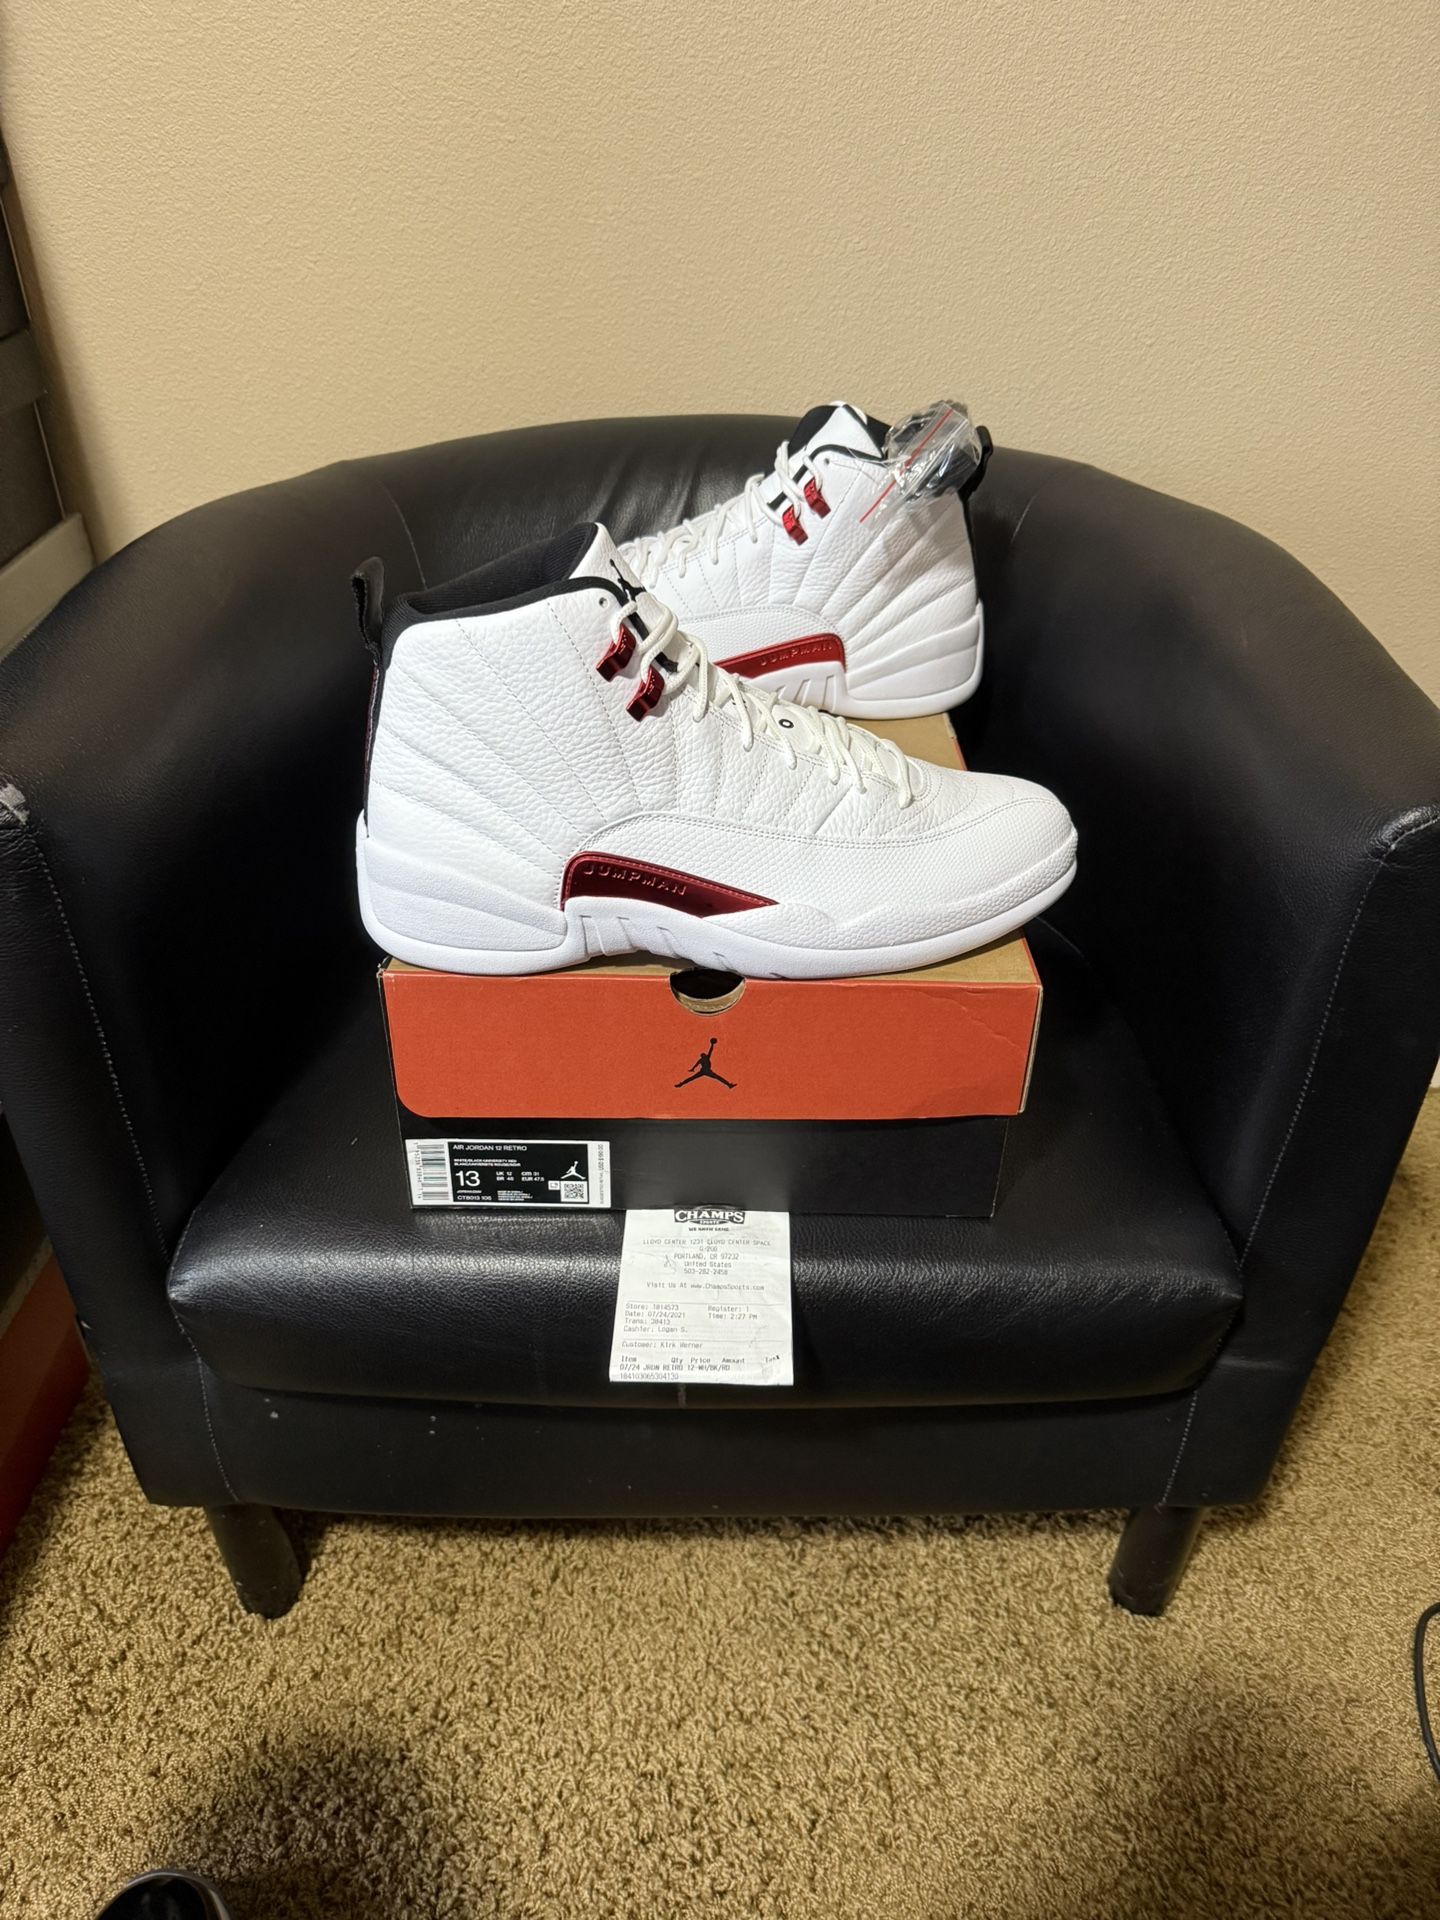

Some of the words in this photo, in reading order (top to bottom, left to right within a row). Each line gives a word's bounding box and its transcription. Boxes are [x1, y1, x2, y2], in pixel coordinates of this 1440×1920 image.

[583, 864, 688, 896] JUMPMAN
[455, 1170, 481, 1187] 13
[675, 1210, 744, 1223] CHAMPS
[646, 1281, 665, 1289] Visit
[647, 1310, 685, 1318] 07/24/2021
